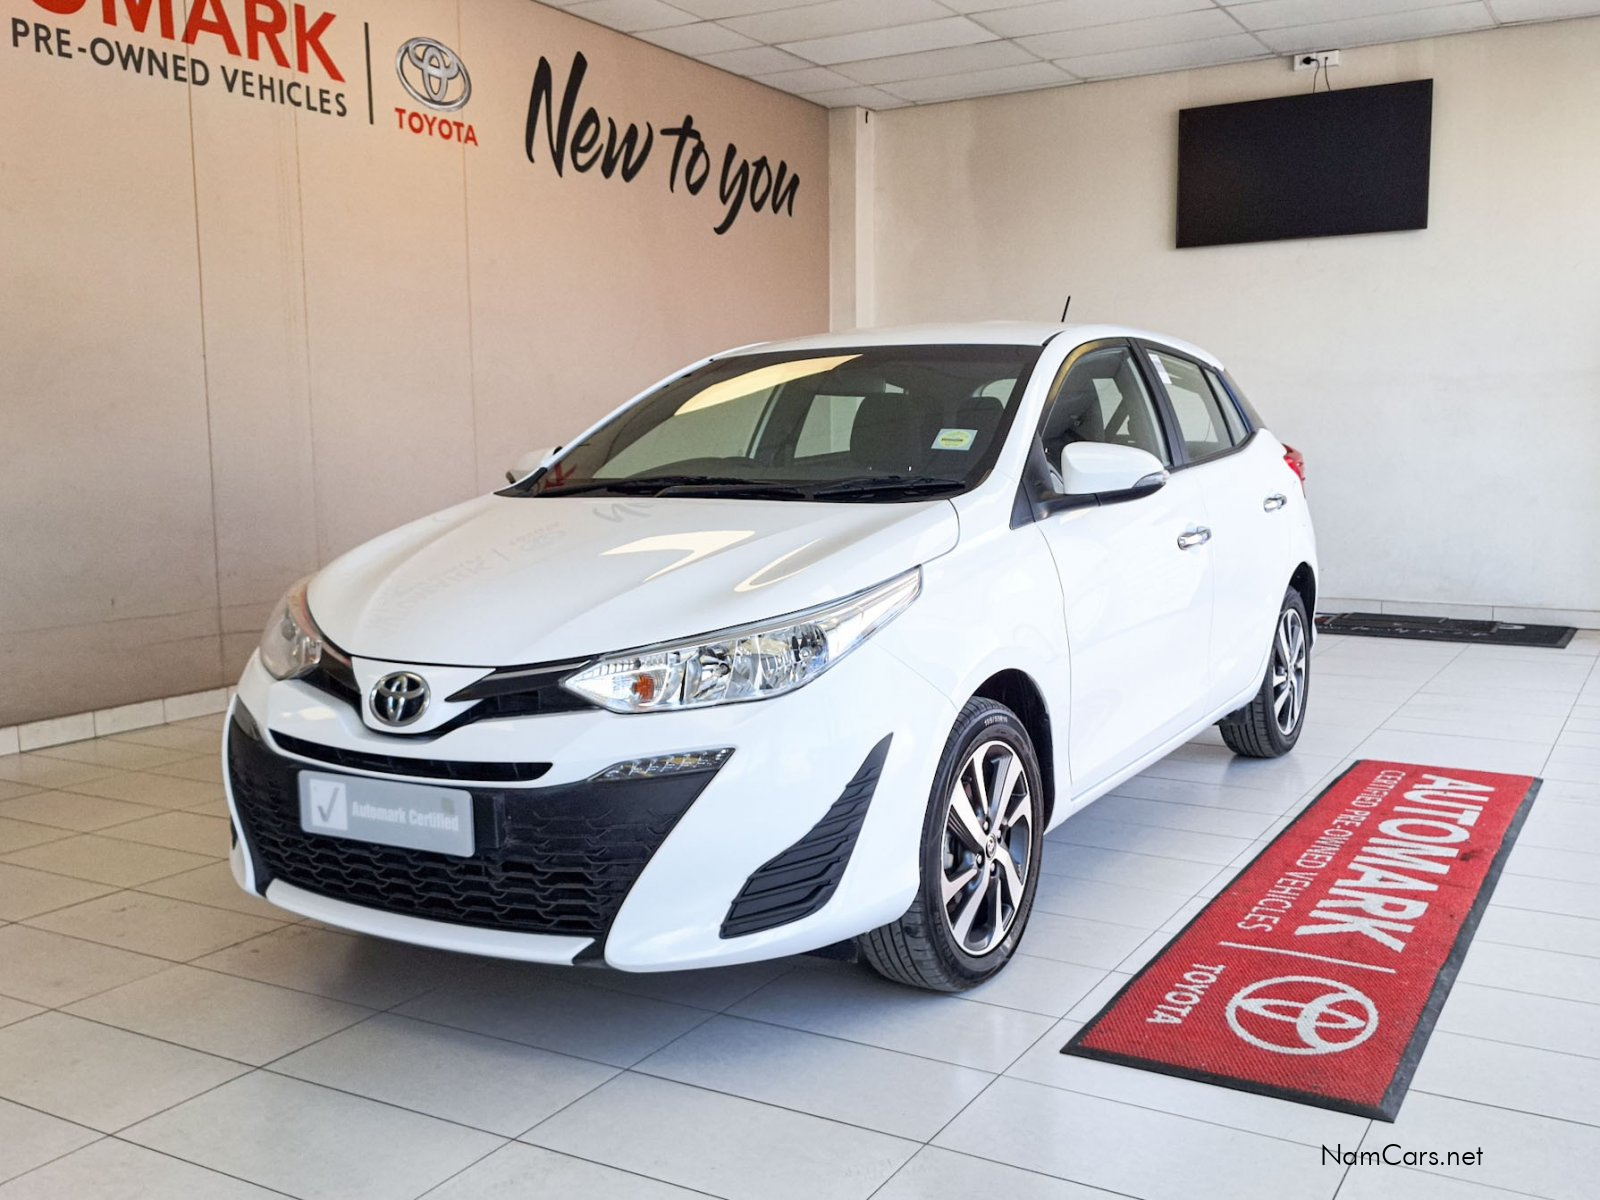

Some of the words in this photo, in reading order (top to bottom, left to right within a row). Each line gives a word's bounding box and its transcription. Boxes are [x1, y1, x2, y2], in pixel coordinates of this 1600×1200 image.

[11, 17, 210, 87] PRE-OWNED
[220, 65, 348, 117] VEHICLES
[394, 107, 479, 147] TOYOTA
[525, 51, 653, 183] New
[660, 115, 711, 196] to
[713, 143, 800, 236] you
[352, 801, 406, 824] Automark
[409, 810, 459, 831] Certified
[1351, 769, 1406, 808] CERTIFIED
[1294, 773, 1495, 953] AUTOMARK
[1296, 808, 1371, 868] PRE-OWNED
[1236, 871, 1319, 932] VEHICLES
[1145, 963, 1227, 1025] TOYOTA
